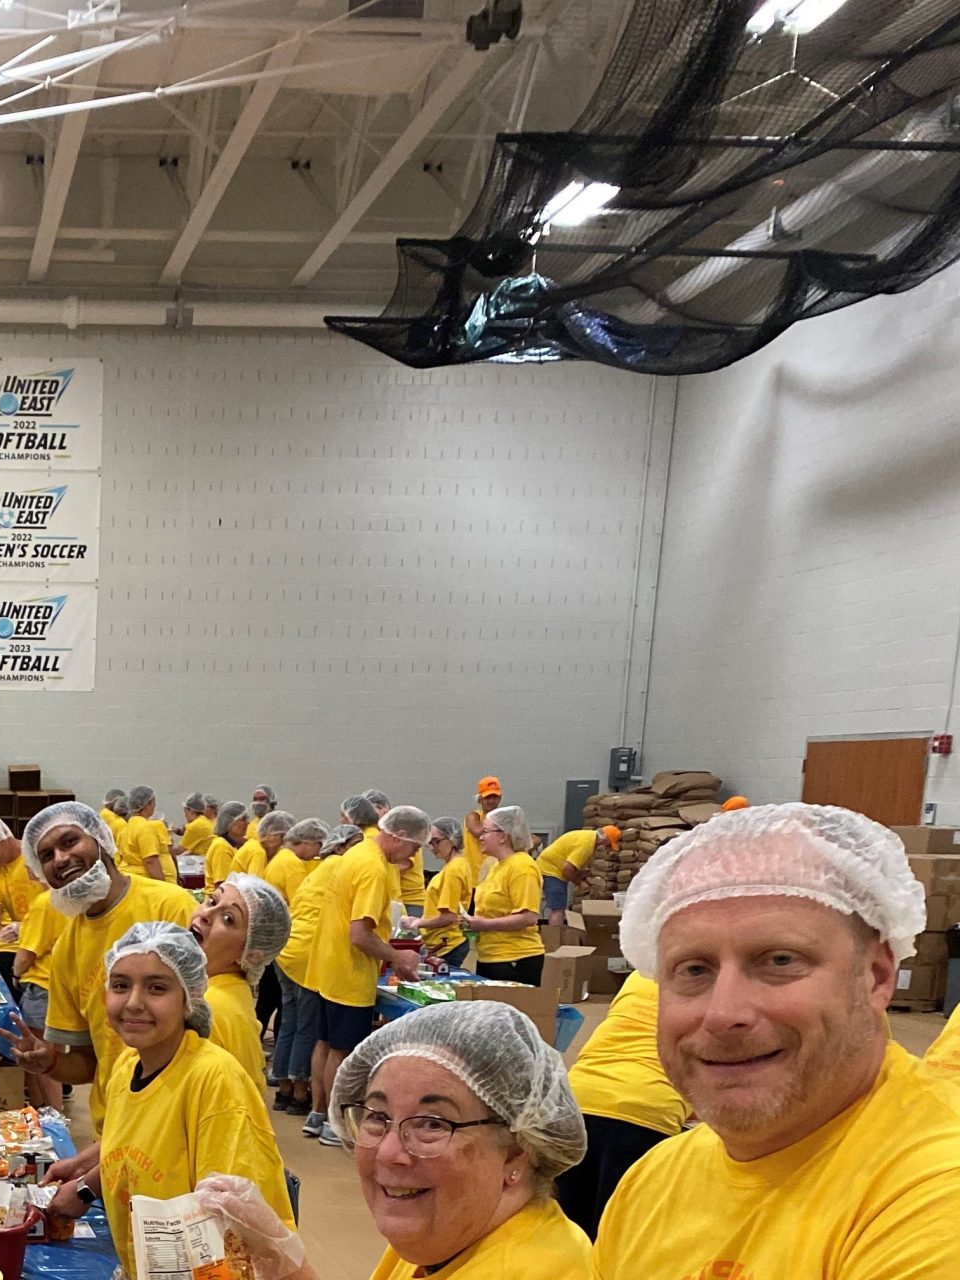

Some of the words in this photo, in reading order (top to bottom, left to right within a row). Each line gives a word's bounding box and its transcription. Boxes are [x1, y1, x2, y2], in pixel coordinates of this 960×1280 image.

[3, 375, 59, 394] UNITED
[18, 396, 56, 412] EAST
[13, 421, 36, 429] 2022
[2, 492, 54, 509] UNITED
[16, 511, 49, 524] EAST
[11, 533, 32, 541] 2022
[31, 544, 87, 558] SOCCER
[0, 602, 53, 619] UNITED
[14, 621, 48, 635] EAST
